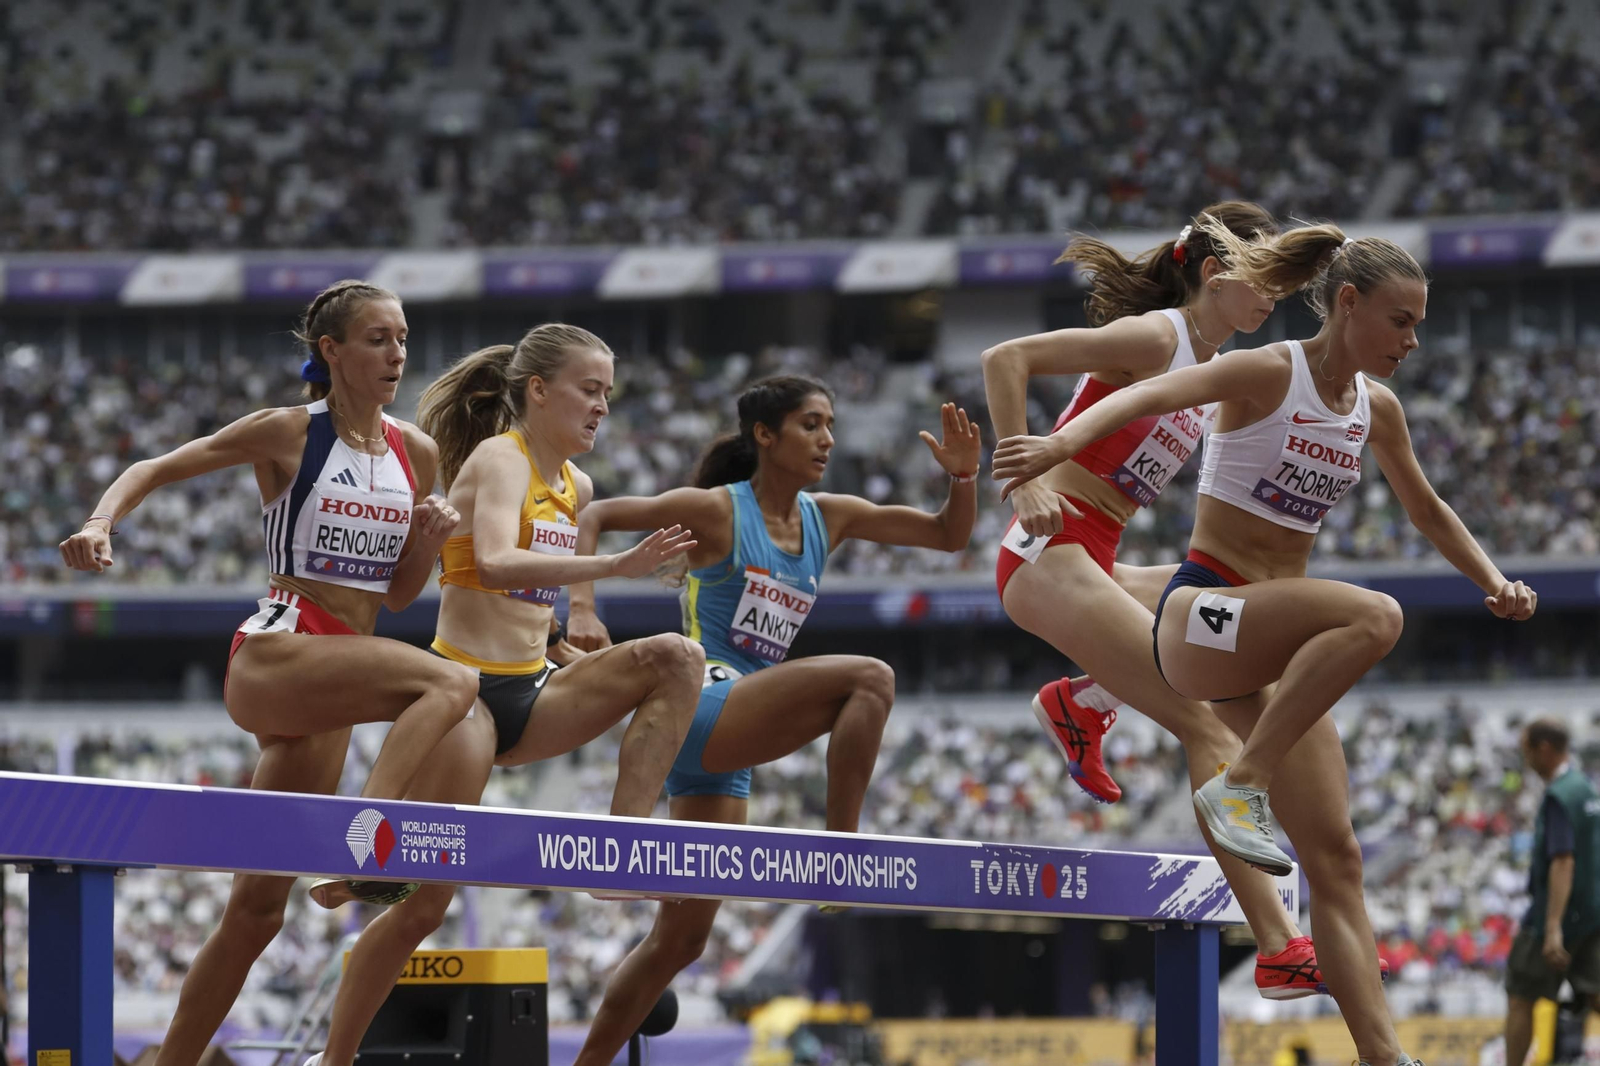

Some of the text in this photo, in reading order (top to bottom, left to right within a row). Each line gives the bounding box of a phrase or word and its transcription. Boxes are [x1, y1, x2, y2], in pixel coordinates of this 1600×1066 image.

[1285, 435, 1361, 472] HONDA
[319, 497, 410, 525] HONDA
[315, 524, 404, 559] RENOUARD
[739, 606, 800, 645] ANKIT
[1199, 606, 1234, 634] 4
[401, 820, 466, 837] WORLD ATHLETICS
[401, 834, 466, 850] CHAMPIONSHIPS
[538, 833, 918, 891] WORLD ATHLETICS CHAMPIONSHIPS
